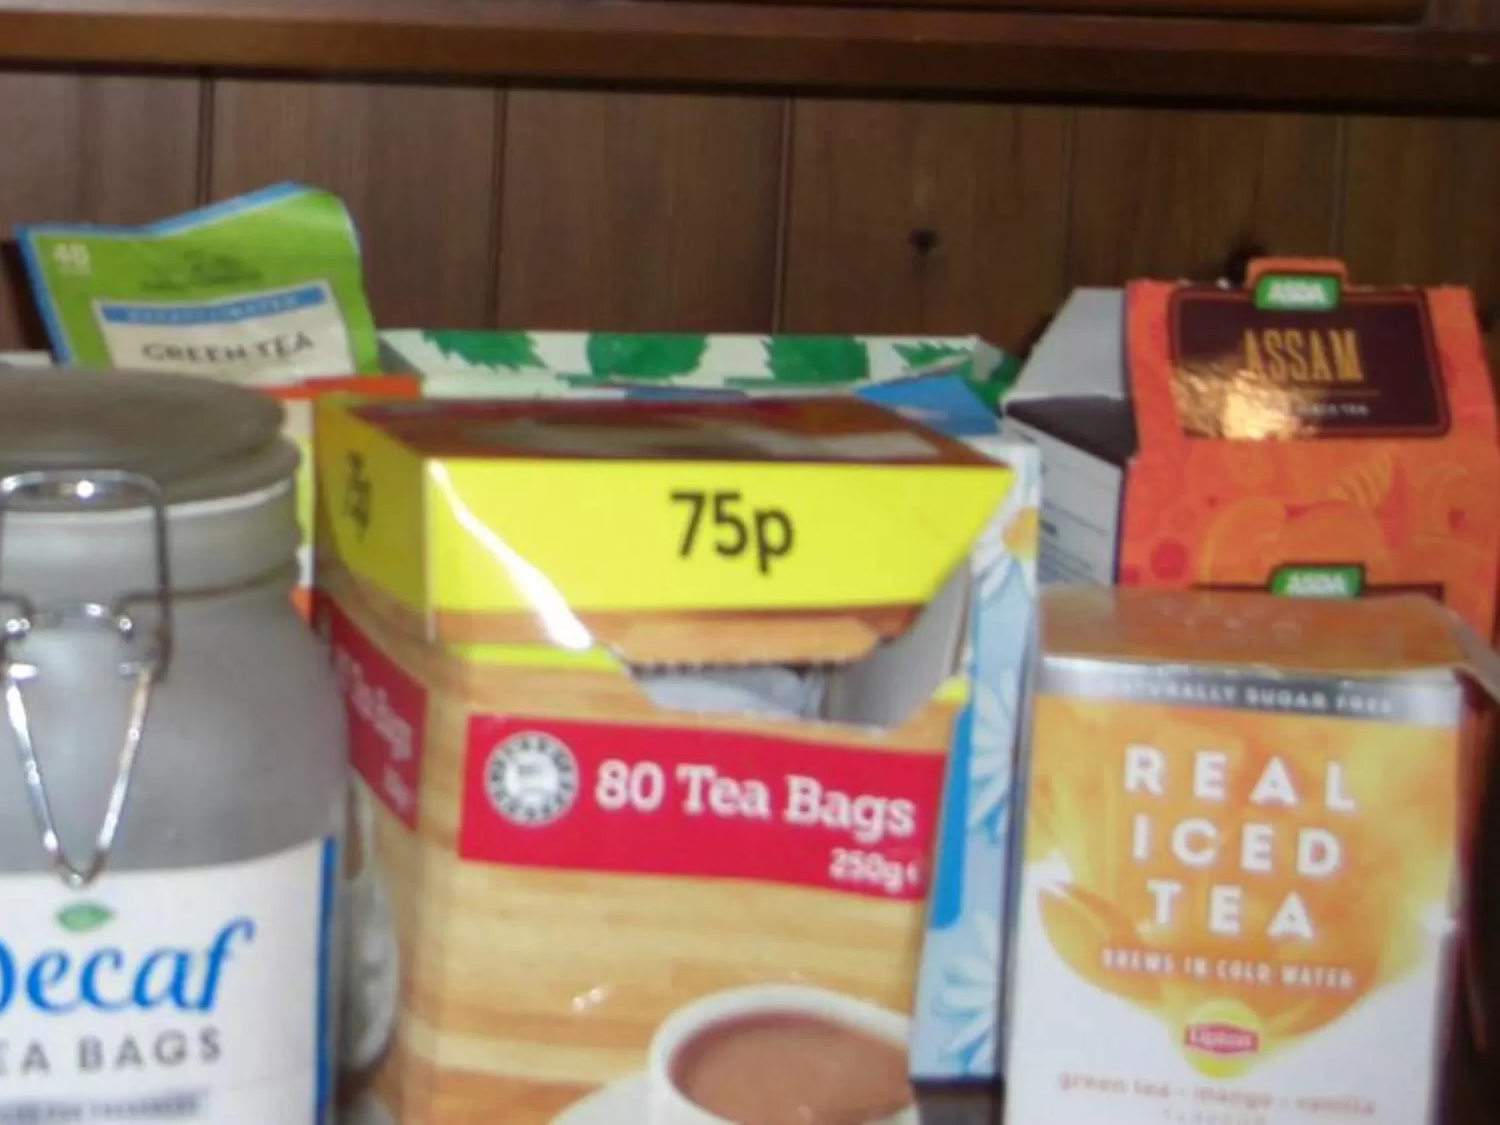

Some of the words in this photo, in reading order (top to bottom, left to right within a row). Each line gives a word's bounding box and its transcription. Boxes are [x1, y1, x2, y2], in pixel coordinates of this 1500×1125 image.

[142, 341, 249, 363] GREEN
[257, 330, 315, 360] TEA
[1242, 328, 1365, 382] ASSAM
[669, 490, 796, 576] 75p
[1245, 681, 1327, 711] SUGAR
[595, 758, 667, 812] 80
[675, 763, 772, 819] Tea
[783, 774, 917, 844] Bags
[1122, 744, 1357, 813] REAL
[828, 847, 905, 891] 250g
[1132, 813, 1342, 876] ICED
[1147, 879, 1315, 940] TEA
[1101, 948, 1175, 974] BREWS
[1183, 955, 1207, 979] IN
[1216, 959, 1272, 984] COLD
[1281, 964, 1355, 989] WATER
[76, 1025, 223, 1075] BAGS
